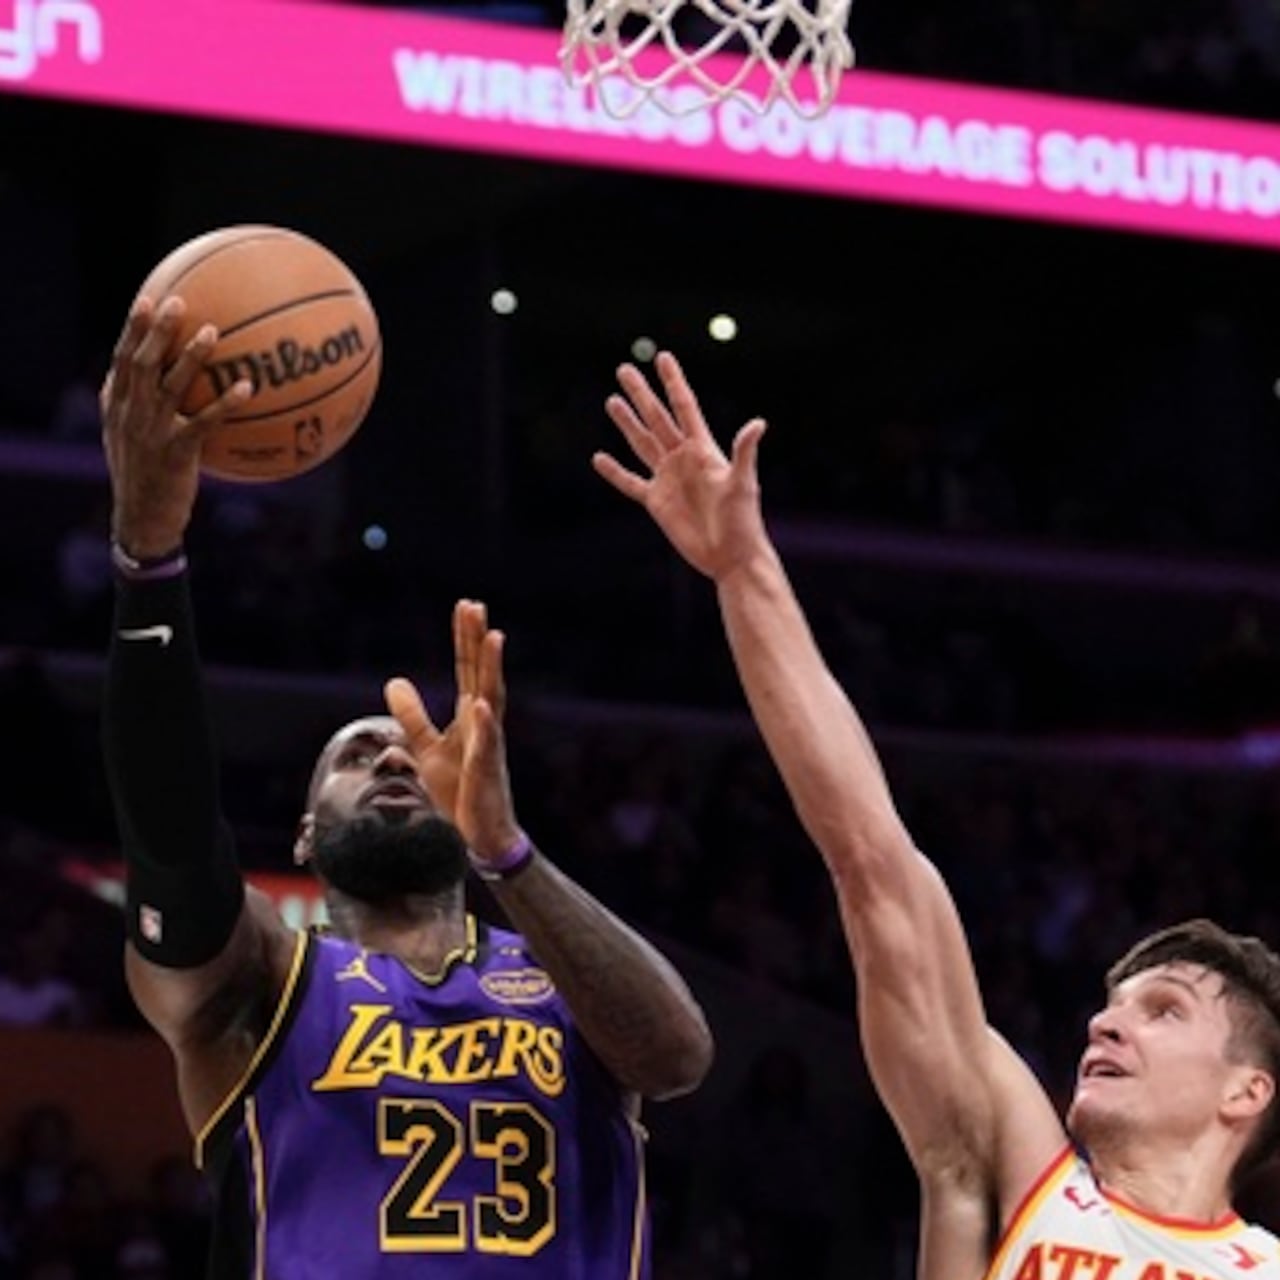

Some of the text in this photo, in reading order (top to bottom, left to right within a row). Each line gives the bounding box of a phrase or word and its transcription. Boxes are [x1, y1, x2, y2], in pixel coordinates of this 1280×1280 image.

[393, 48, 713, 146] WIRELESS
[719, 90, 1032, 187] COVERAGE
[202, 322, 364, 398] Wilson
[312, 1004, 566, 1098] LAKERS
[378, 1098, 556, 1257] 23
